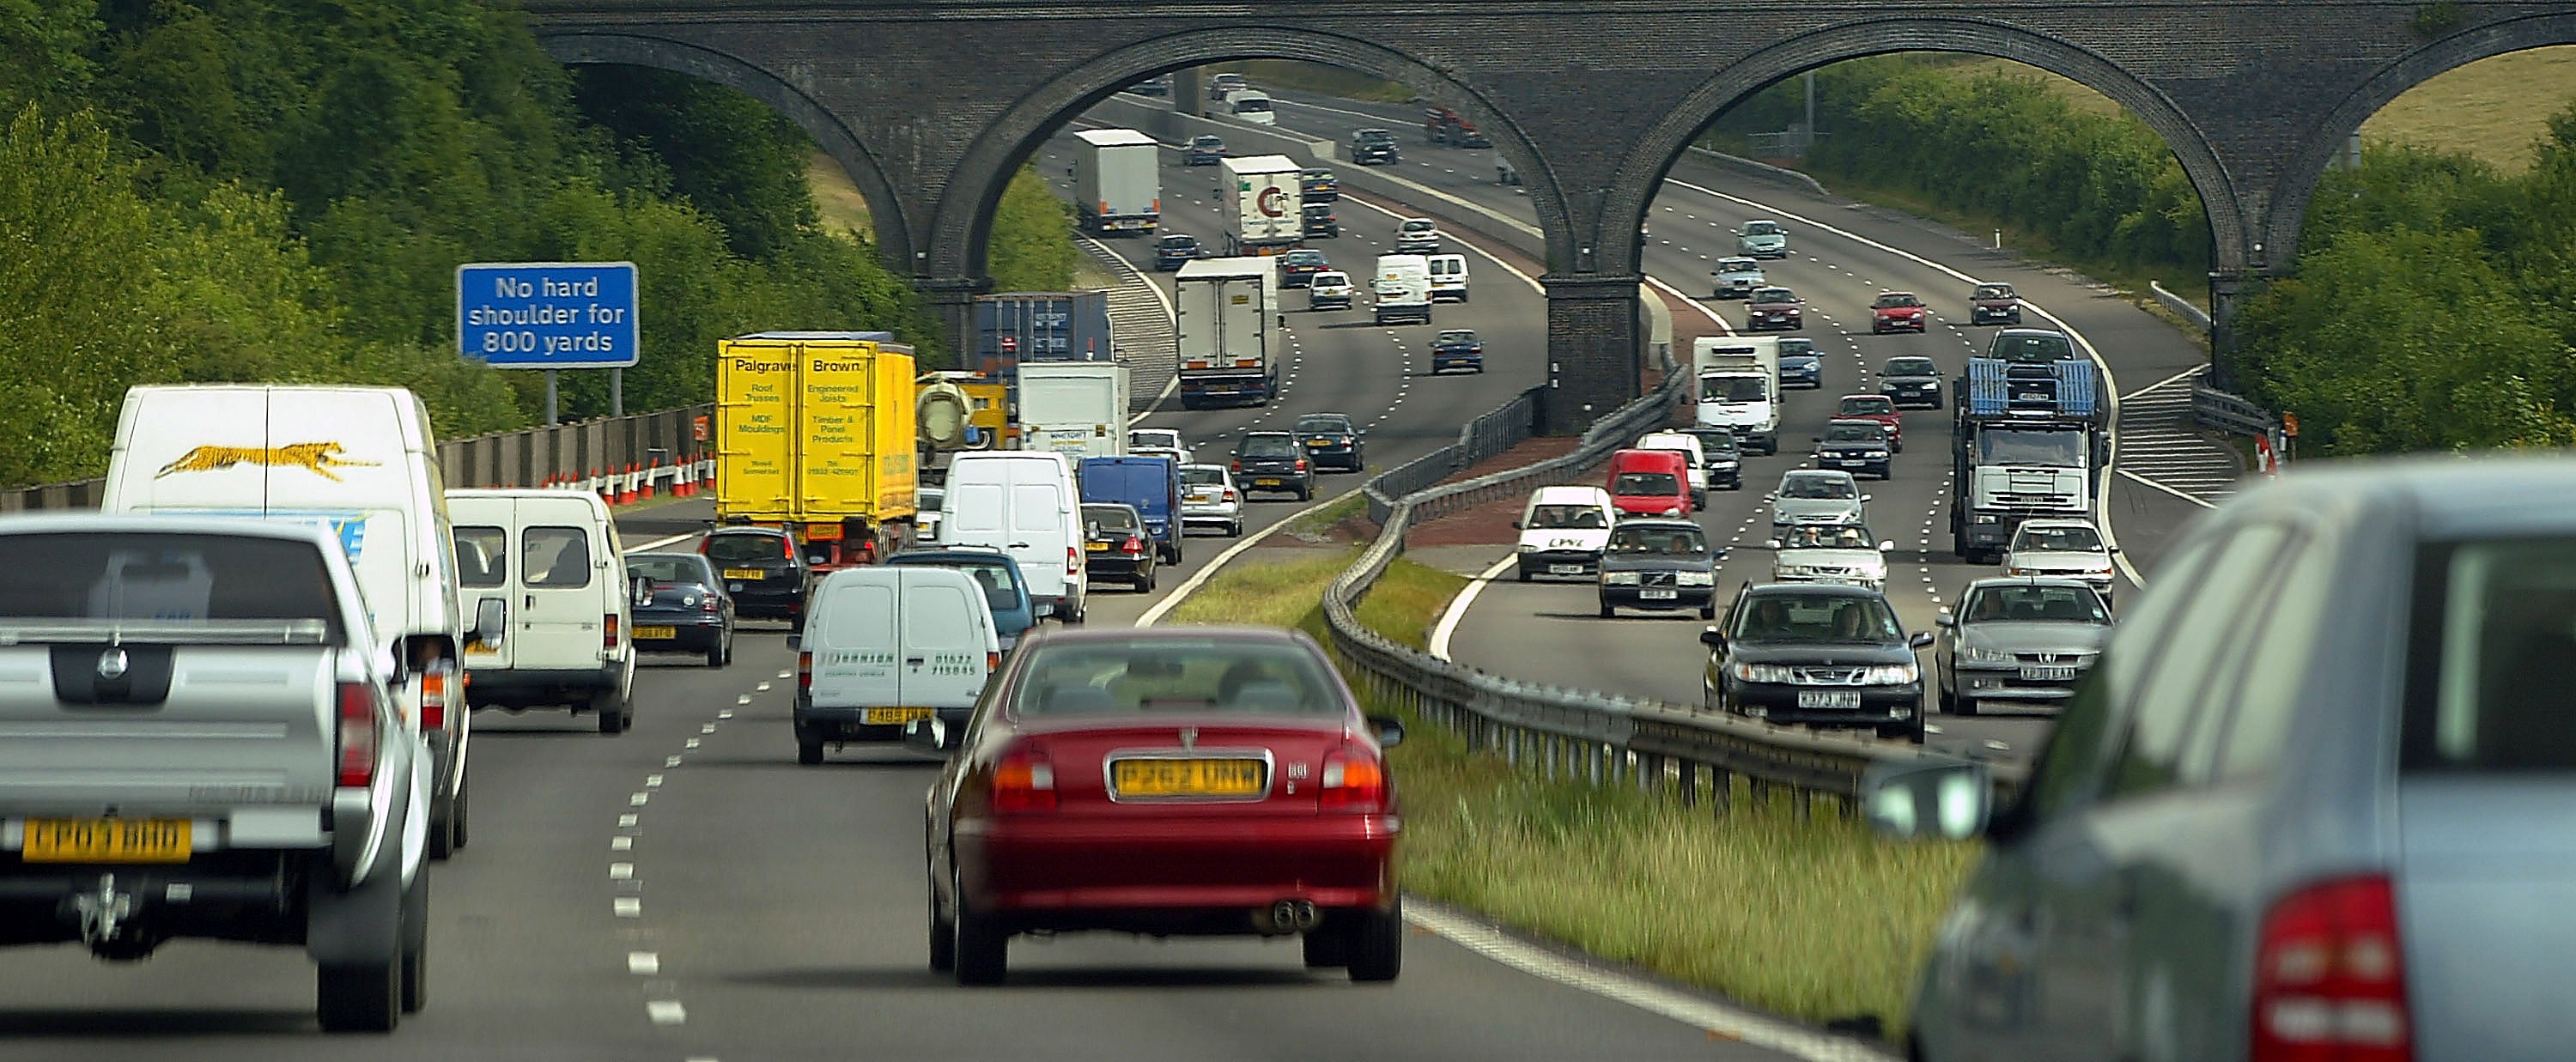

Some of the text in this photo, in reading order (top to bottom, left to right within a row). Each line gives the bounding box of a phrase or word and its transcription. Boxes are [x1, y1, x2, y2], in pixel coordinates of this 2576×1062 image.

[495, 276, 598, 298] No hard
[468, 304, 625, 325] shoulder for
[483, 331, 612, 355] 800 yards
[736, 359, 860, 374] Palgrave Brown
[751, 384, 773, 392] Roof
